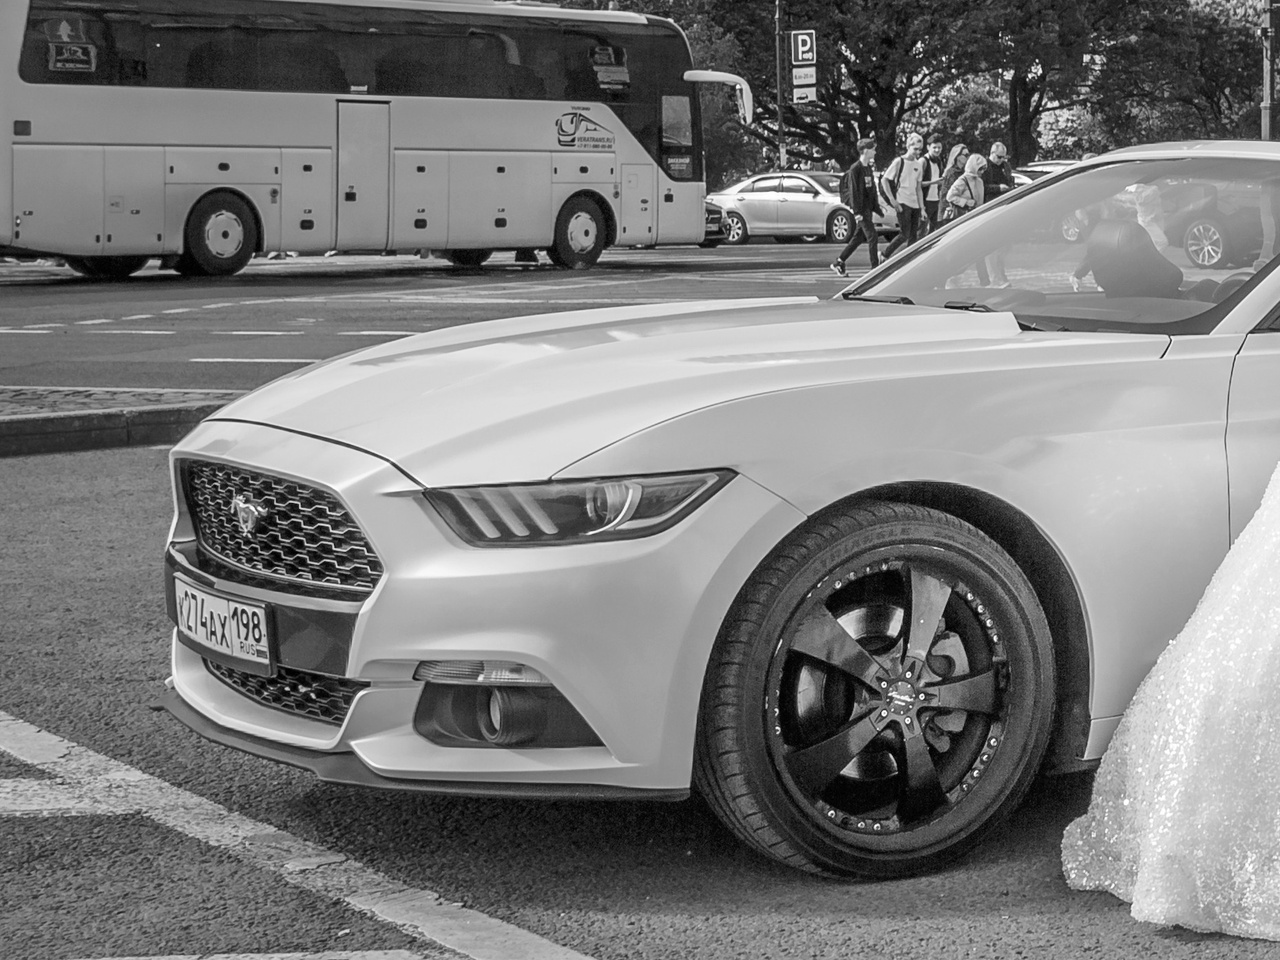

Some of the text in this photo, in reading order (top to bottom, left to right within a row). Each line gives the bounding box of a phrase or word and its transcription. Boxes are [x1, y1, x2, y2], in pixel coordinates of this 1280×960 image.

[798, 35, 811, 60] P
[231, 606, 263, 644] 198
[239, 641, 256, 656] RUS
